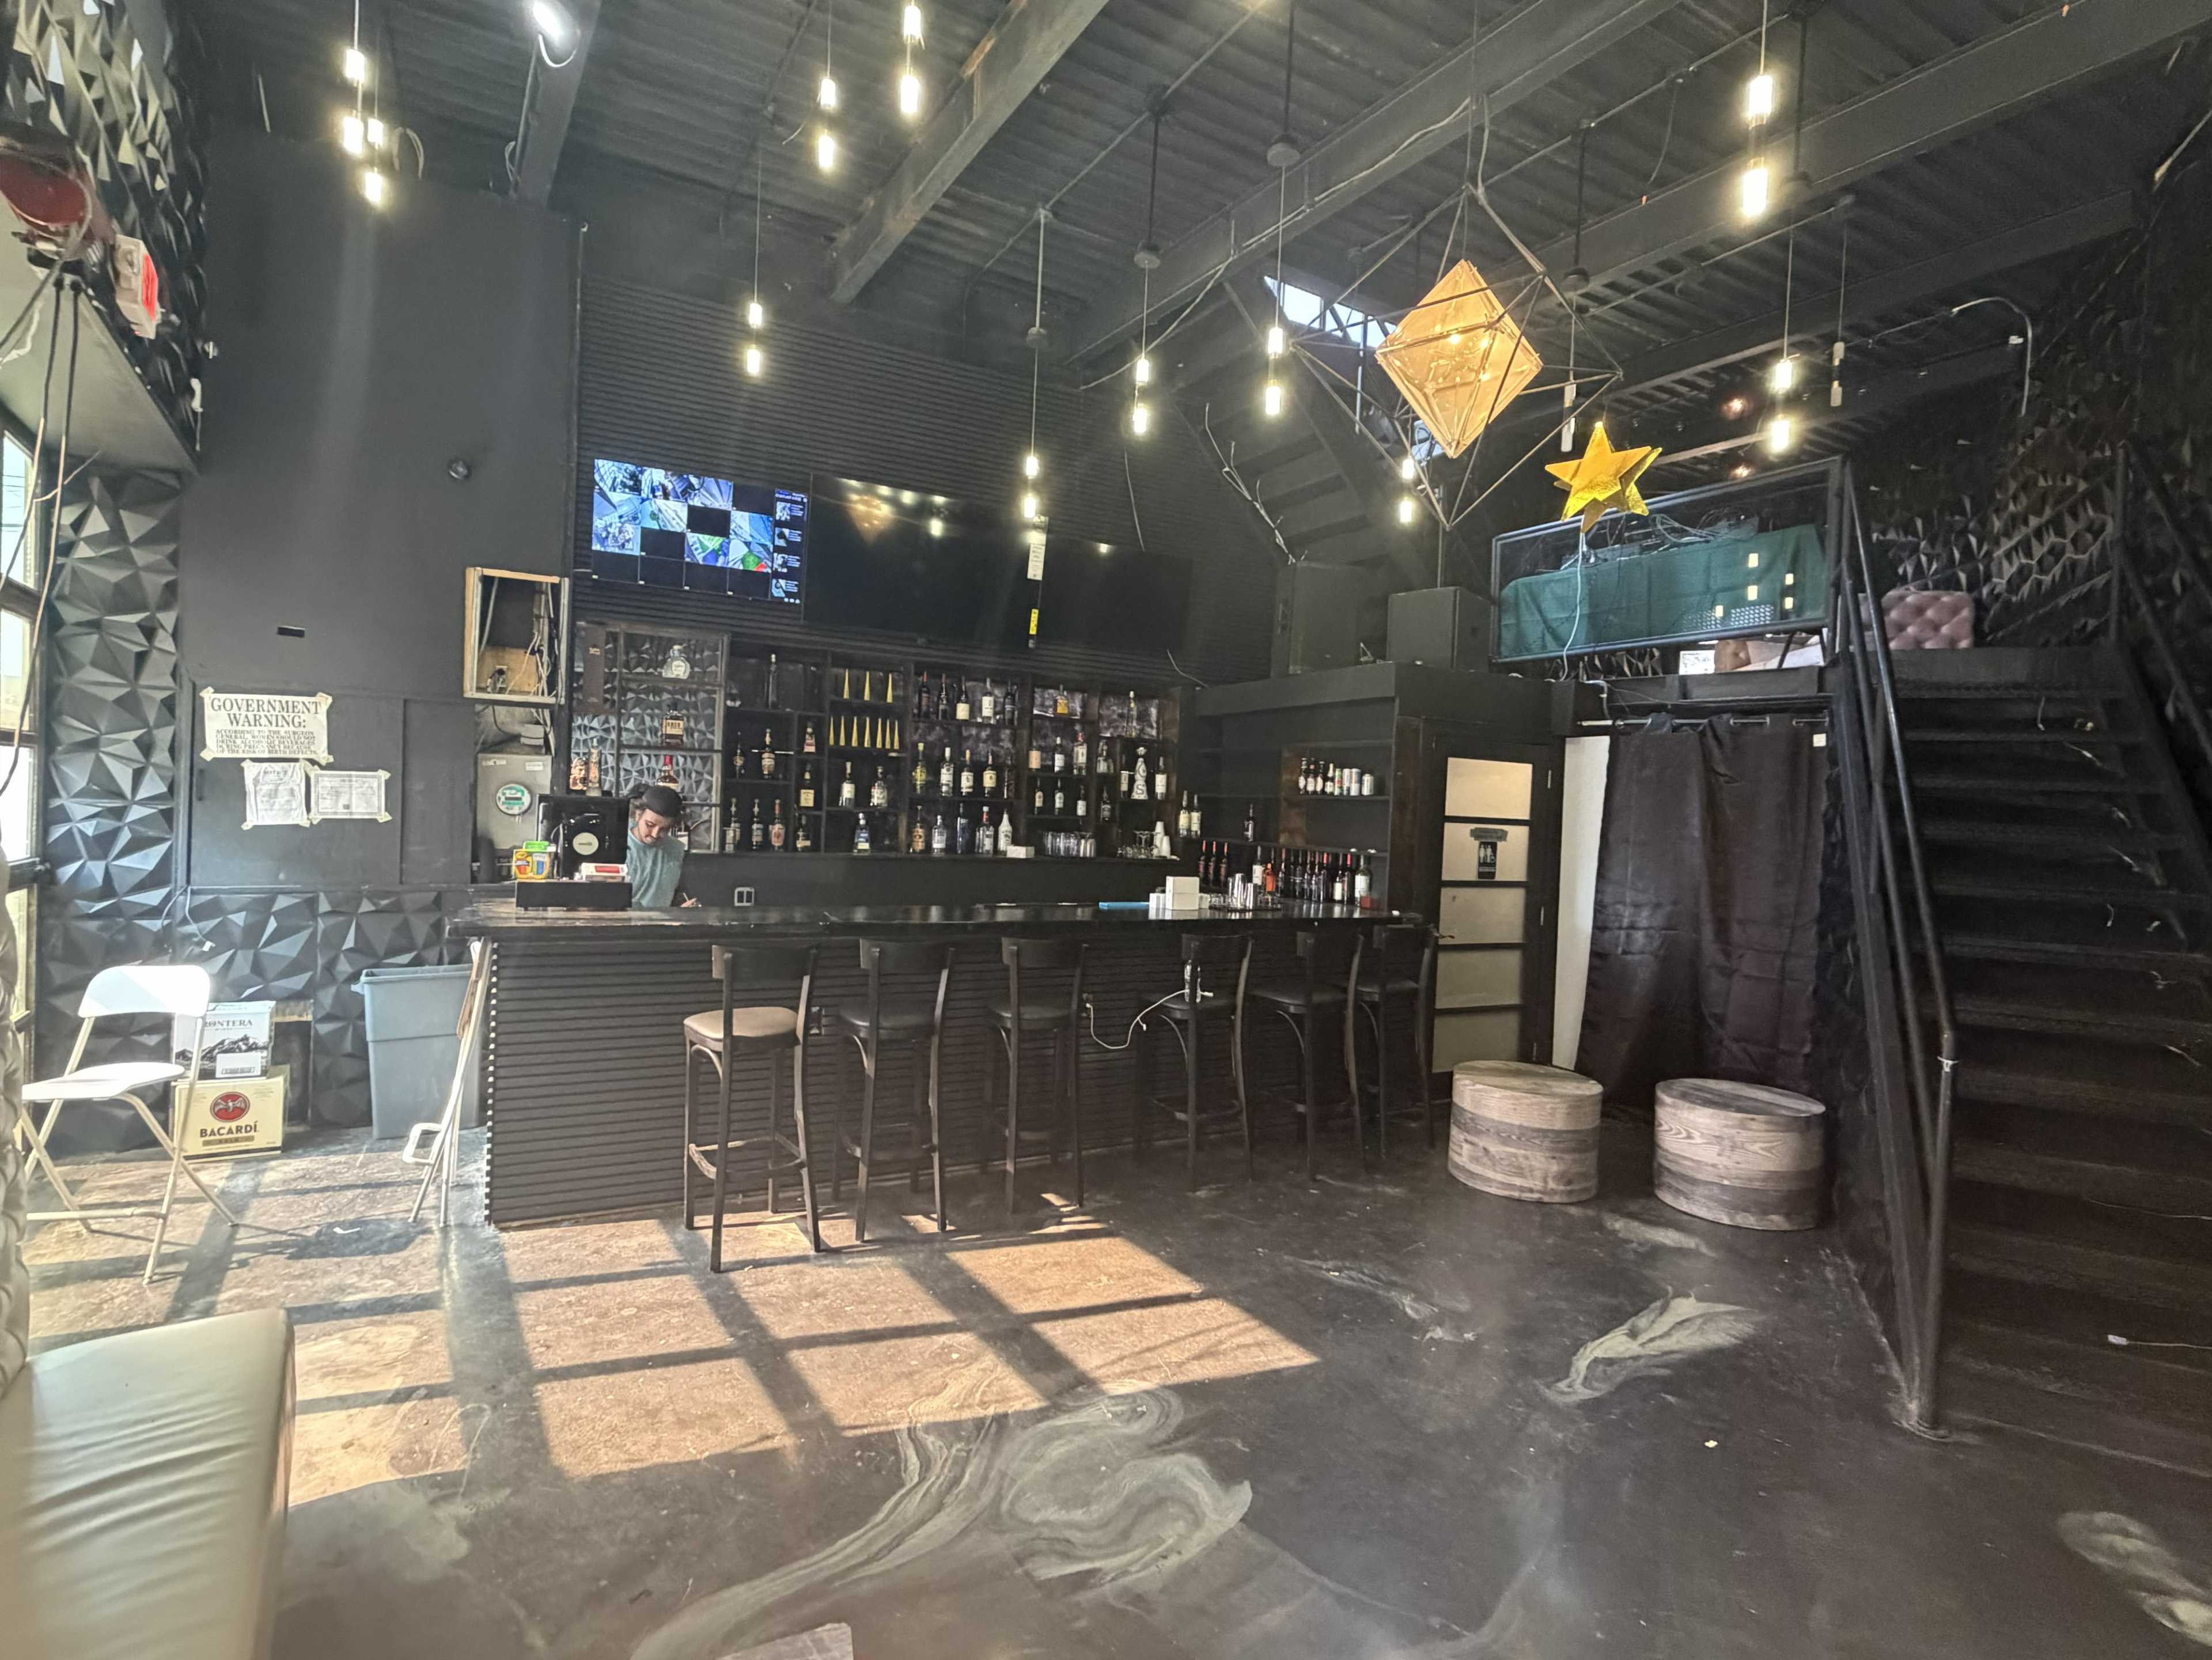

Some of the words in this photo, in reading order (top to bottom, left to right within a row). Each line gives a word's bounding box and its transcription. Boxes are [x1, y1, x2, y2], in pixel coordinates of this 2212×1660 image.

[211, 697, 321, 714] GOVERNMENT
[226, 713, 306, 728] WARNING:
[196, 1019, 253, 1028] RONTERA
[200, 1121, 259, 1138] BACARDÍ
